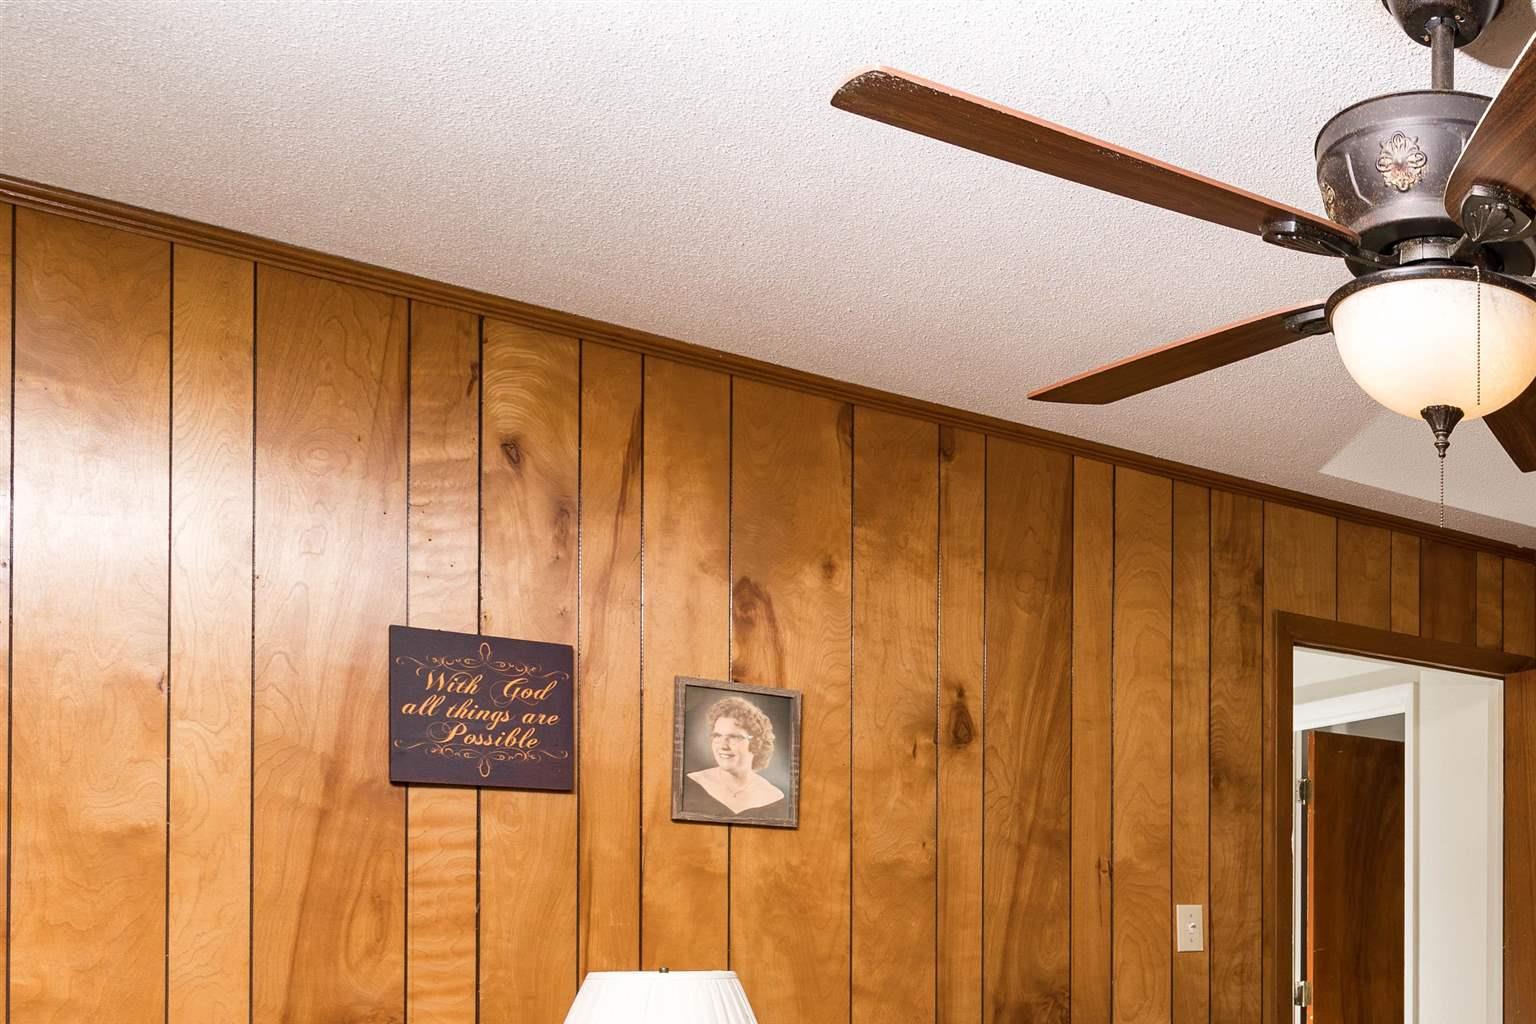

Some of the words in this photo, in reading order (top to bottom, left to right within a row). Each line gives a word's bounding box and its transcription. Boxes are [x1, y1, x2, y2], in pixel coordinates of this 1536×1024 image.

[416, 667, 484, 695] With
[490, 677, 558, 706] God
[401, 694, 447, 717] all
[446, 698, 513, 731] things
[522, 711, 562, 726] are
[426, 720, 541, 749] Possible
